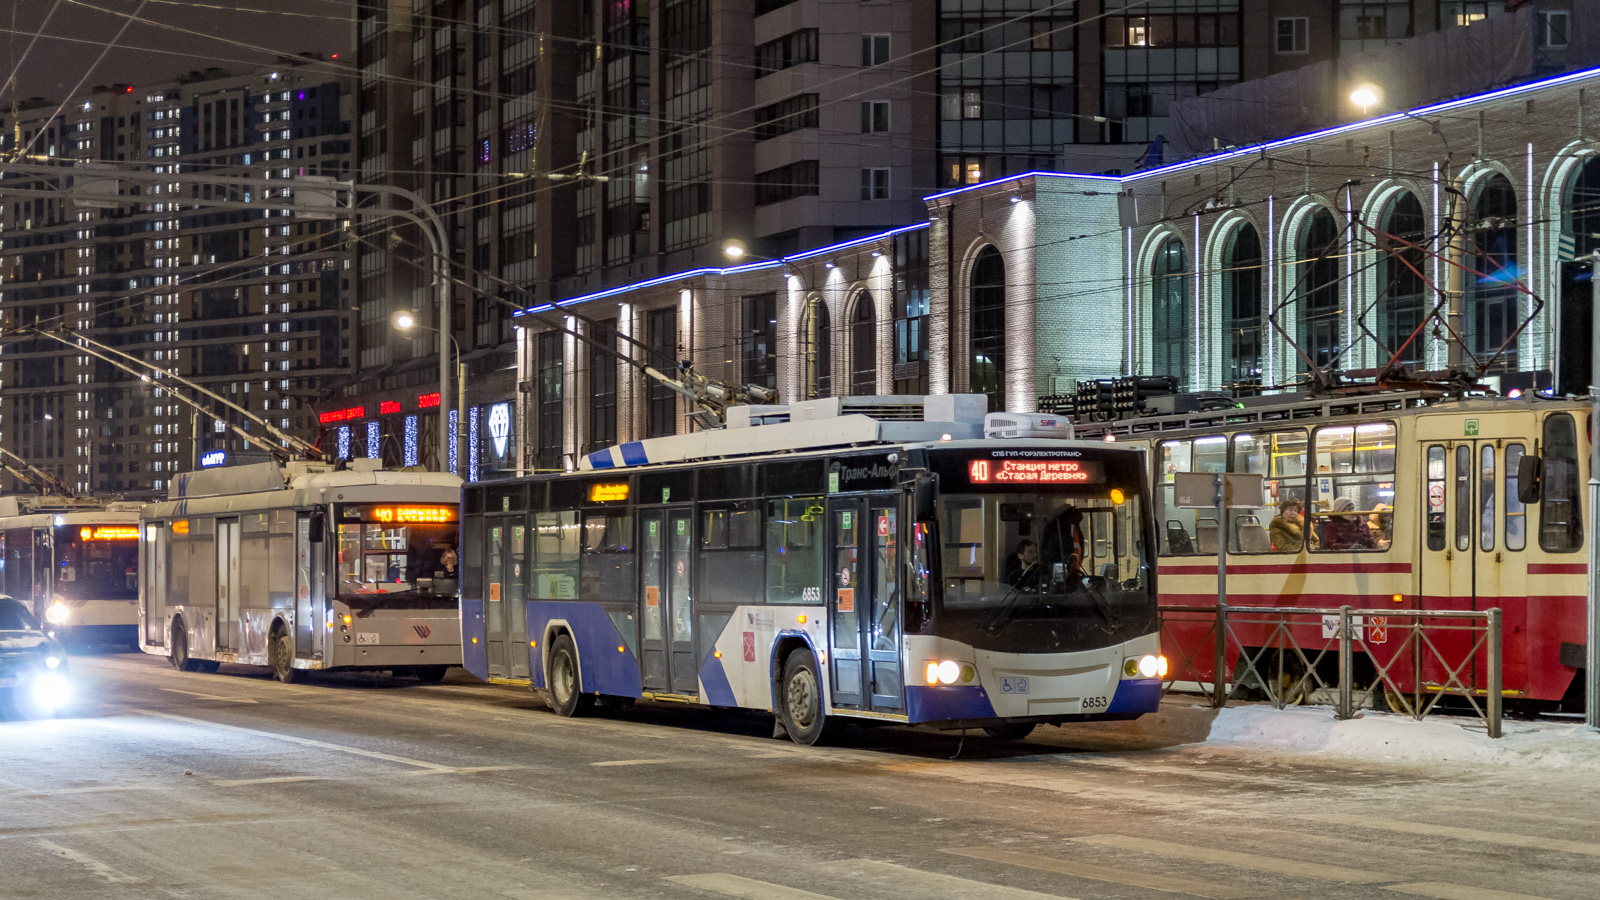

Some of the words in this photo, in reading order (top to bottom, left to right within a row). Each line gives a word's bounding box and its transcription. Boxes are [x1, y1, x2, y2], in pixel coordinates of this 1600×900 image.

[419, 393, 440, 408] ЗОЛОТО
[841, 463, 899, 483] Транс-Альф
[971, 461, 988, 480] 40
[1004, 461, 1046, 471] Станция
[1048, 463, 1079, 471] метро
[995, 471, 1038, 480] «Старая
[1039, 471, 1088, 480] Деревня»
[802, 587, 820, 601] 6853
[1082, 696, 1107, 708] 6853
